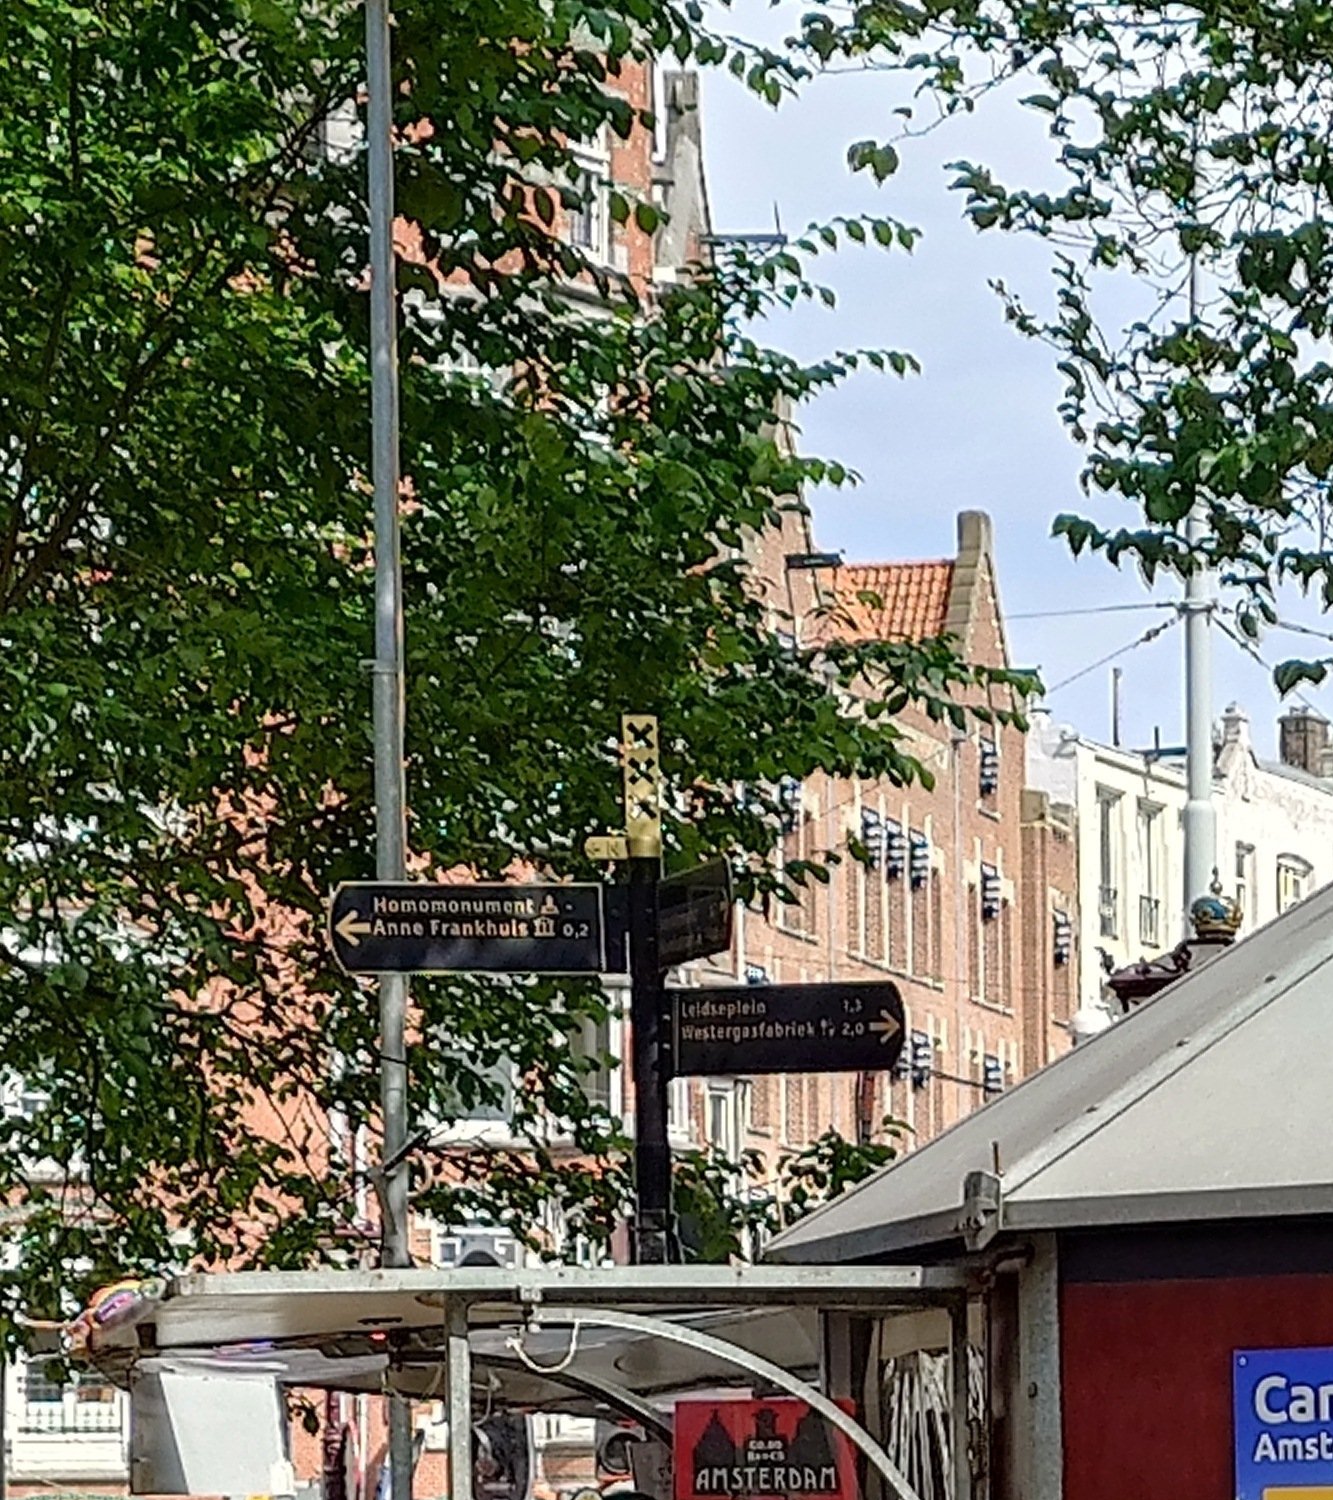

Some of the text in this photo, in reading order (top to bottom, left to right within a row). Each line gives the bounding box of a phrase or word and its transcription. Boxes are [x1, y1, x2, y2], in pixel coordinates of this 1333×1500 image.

[373, 896, 535, 915] Homomonument
[372, 918, 590, 940] Anne Frankhuis 0,2
[680, 1000, 766, 1020] Leidseplein
[681, 1017, 865, 1042] Westergasfabriek 2,0
[695, 1466, 838, 1491] AMSTERDAM
